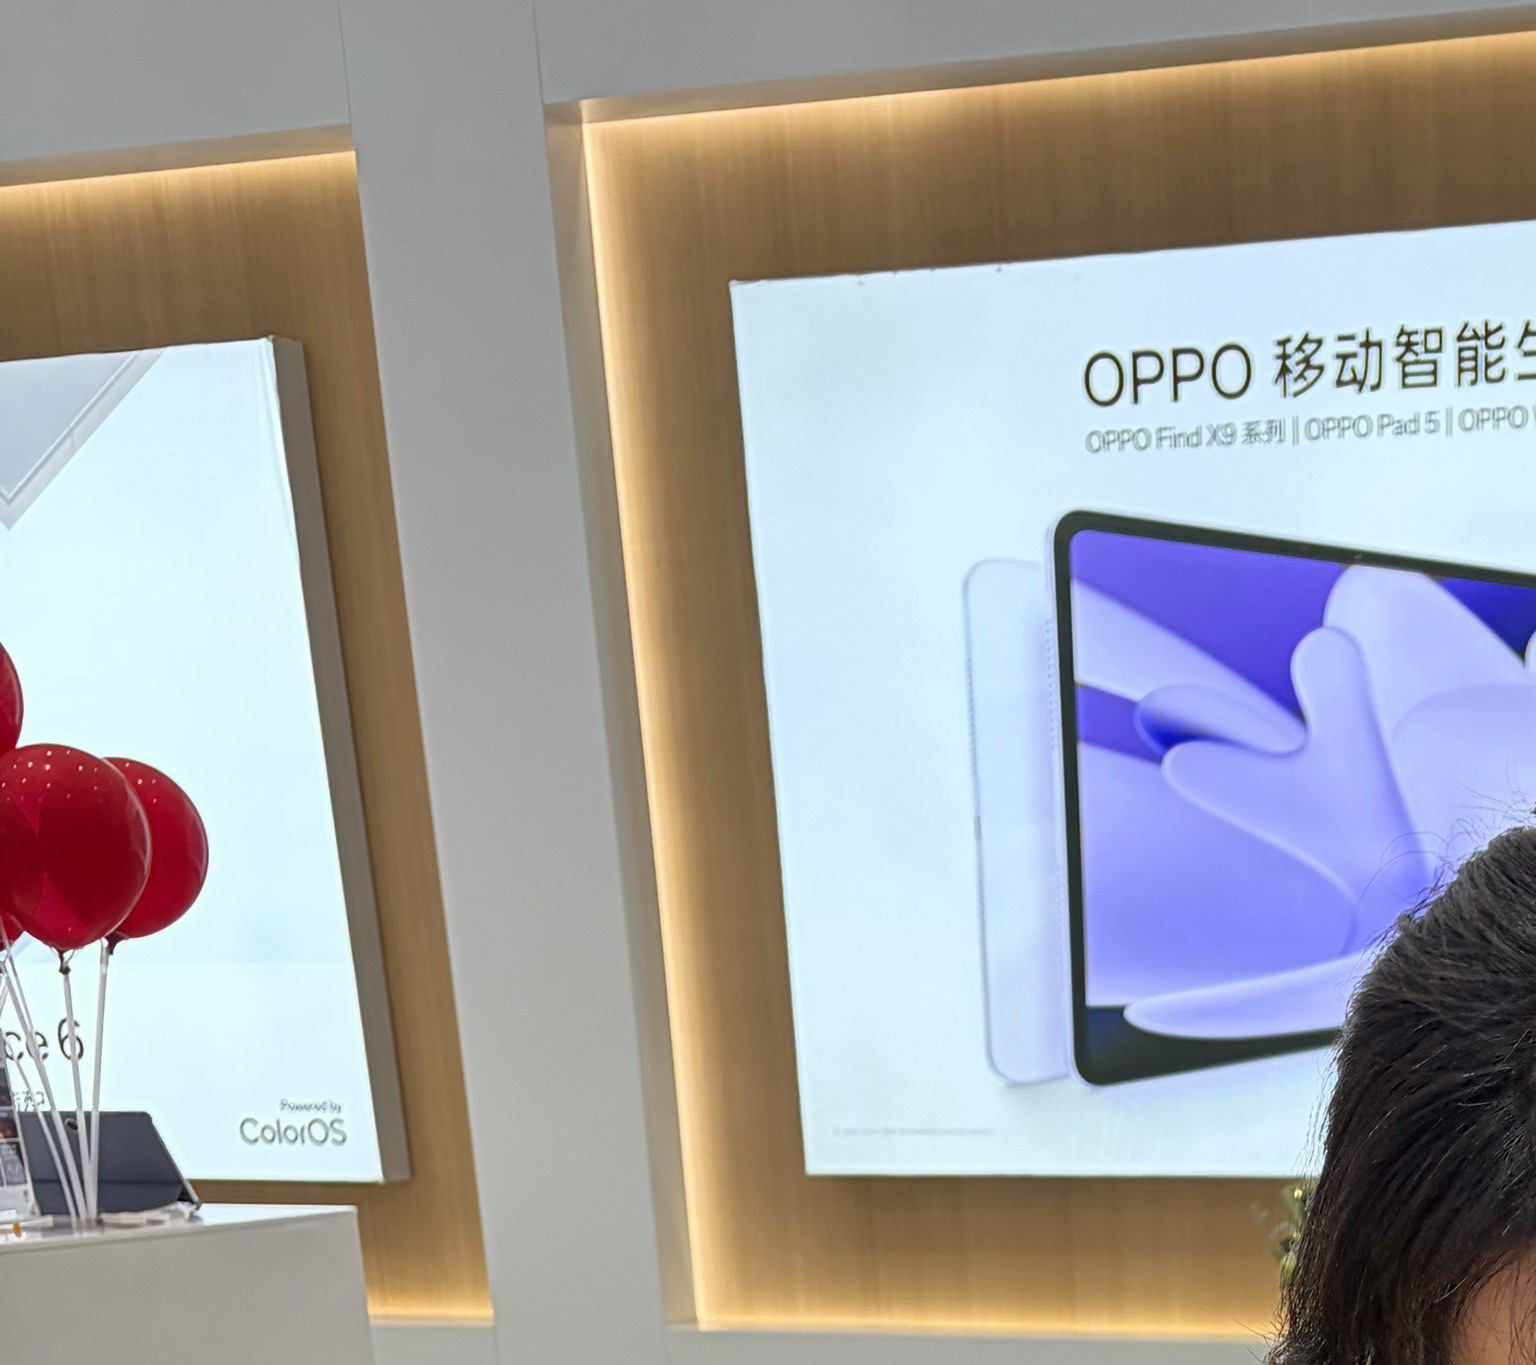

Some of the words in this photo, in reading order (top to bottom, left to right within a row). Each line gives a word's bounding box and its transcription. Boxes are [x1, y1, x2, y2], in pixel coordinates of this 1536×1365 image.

[1084, 343, 1253, 408] OPPO
[1085, 428, 1152, 454] OPPO
[1155, 424, 1203, 450] Find
[1205, 421, 1238, 448] X9
[1242, 417, 1287, 446] 系列
[1304, 413, 1374, 442] OPPO
[1376, 410, 1421, 437] Pad
[1424, 410, 1440, 435] 5
[1457, 404, 1530, 433] OPPO
[58, 1017, 84, 1060] 6
[239, 1117, 348, 1146] ColorOS
